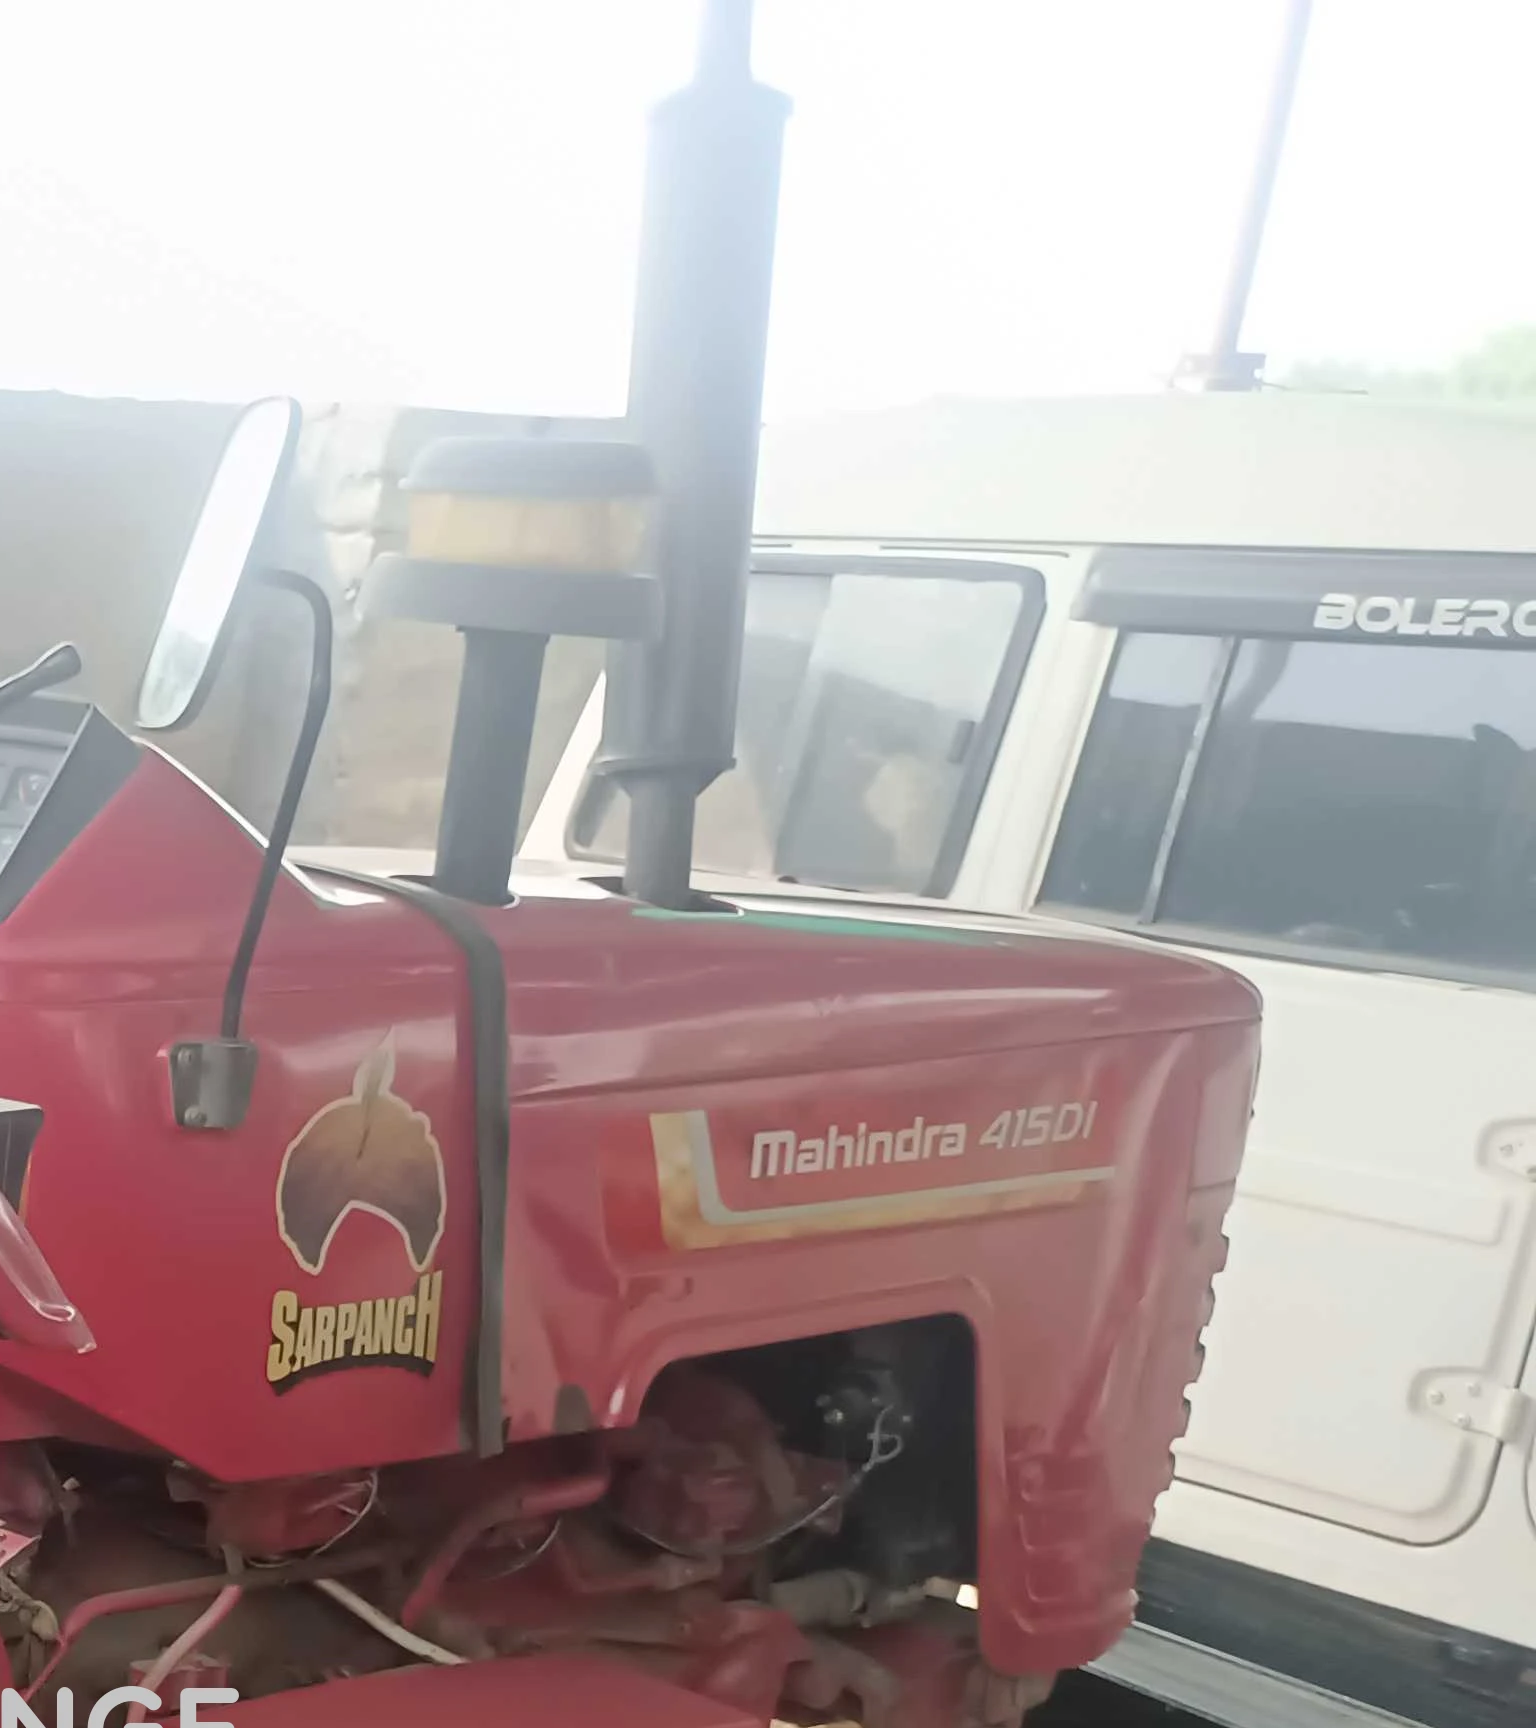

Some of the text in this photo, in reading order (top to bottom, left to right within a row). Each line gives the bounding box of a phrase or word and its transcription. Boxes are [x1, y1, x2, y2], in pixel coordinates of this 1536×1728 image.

[750, 1101, 1098, 1179] Mahindra 415DI
[266, 1271, 443, 1382] SARPANCH
